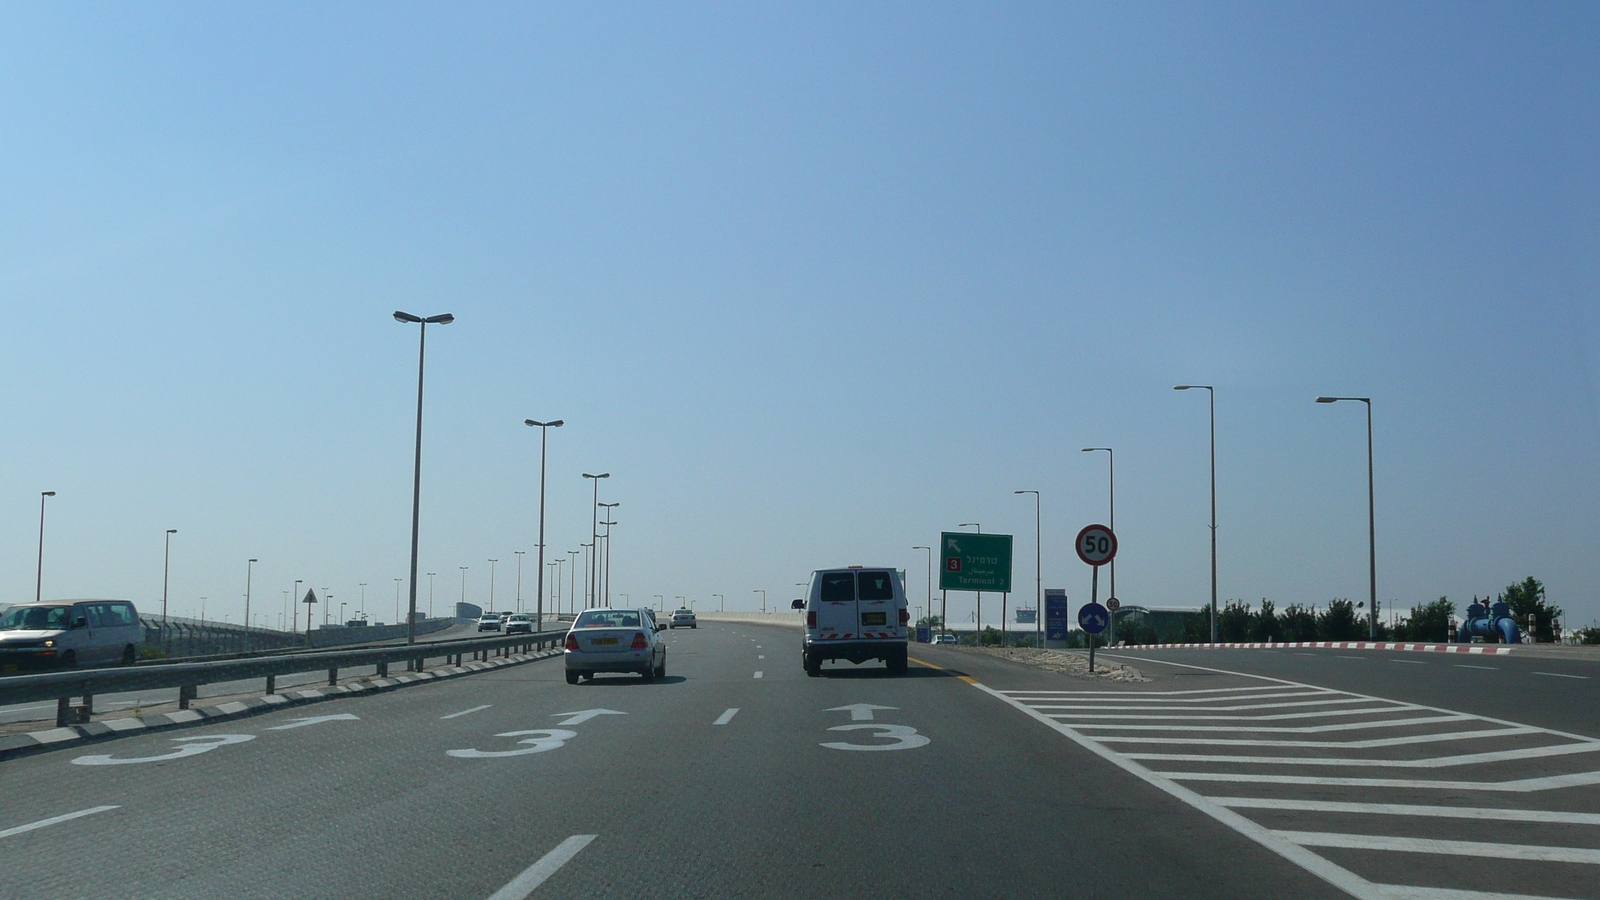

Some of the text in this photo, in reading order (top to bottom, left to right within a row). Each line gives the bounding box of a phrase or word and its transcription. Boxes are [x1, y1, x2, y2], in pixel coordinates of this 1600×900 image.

[1085, 535, 1109, 554] 50
[950, 559, 958, 570] 3
[966, 555, 998, 565] טרמינל
[958, 576, 1004, 586] Terminal 3
[446, 728, 578, 758] 3
[819, 724, 930, 752] 3
[70, 733, 257, 766] 3
